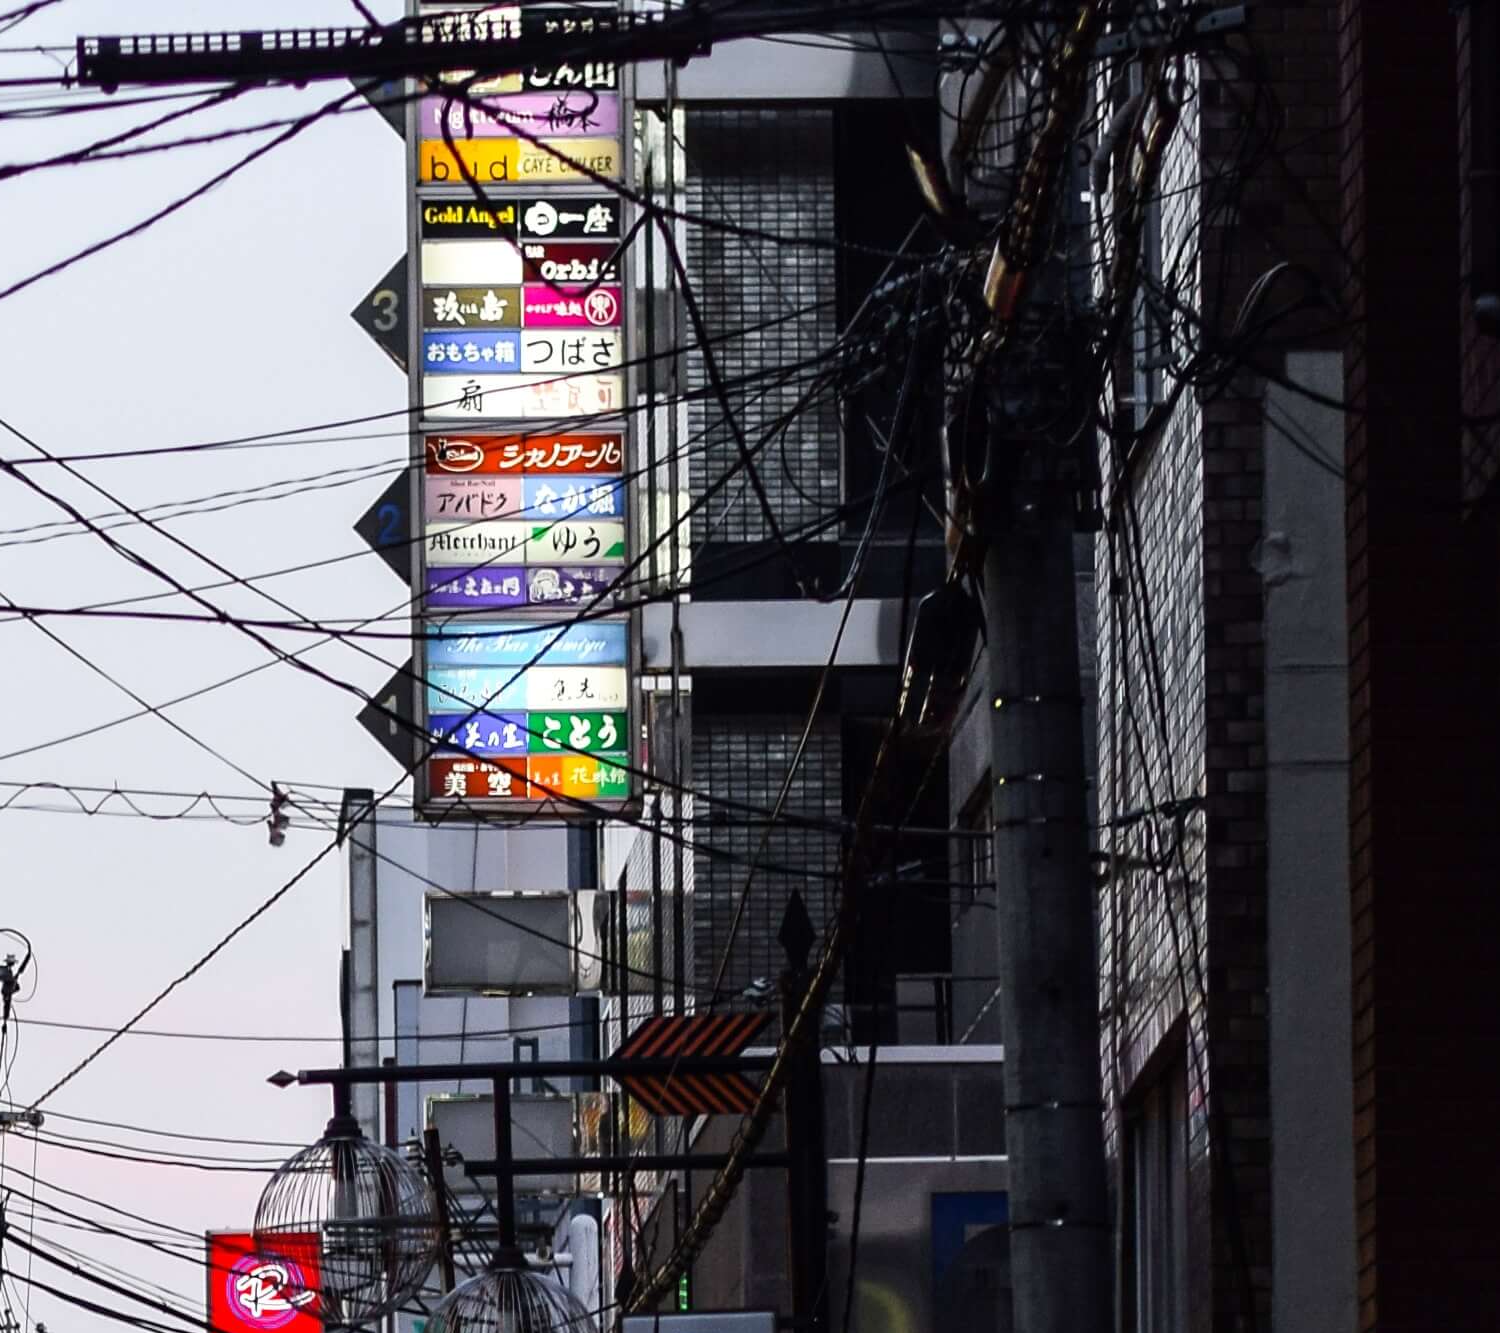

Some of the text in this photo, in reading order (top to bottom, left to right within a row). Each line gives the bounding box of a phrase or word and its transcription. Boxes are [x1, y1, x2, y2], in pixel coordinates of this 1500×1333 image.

[424, 206, 465, 224] Gold
[372, 290, 399, 331] 3
[526, 337, 615, 367] つばさ
[378, 509, 399, 544] 2
[552, 526, 601, 558] ゆう
[429, 532, 517, 553] Merchant
